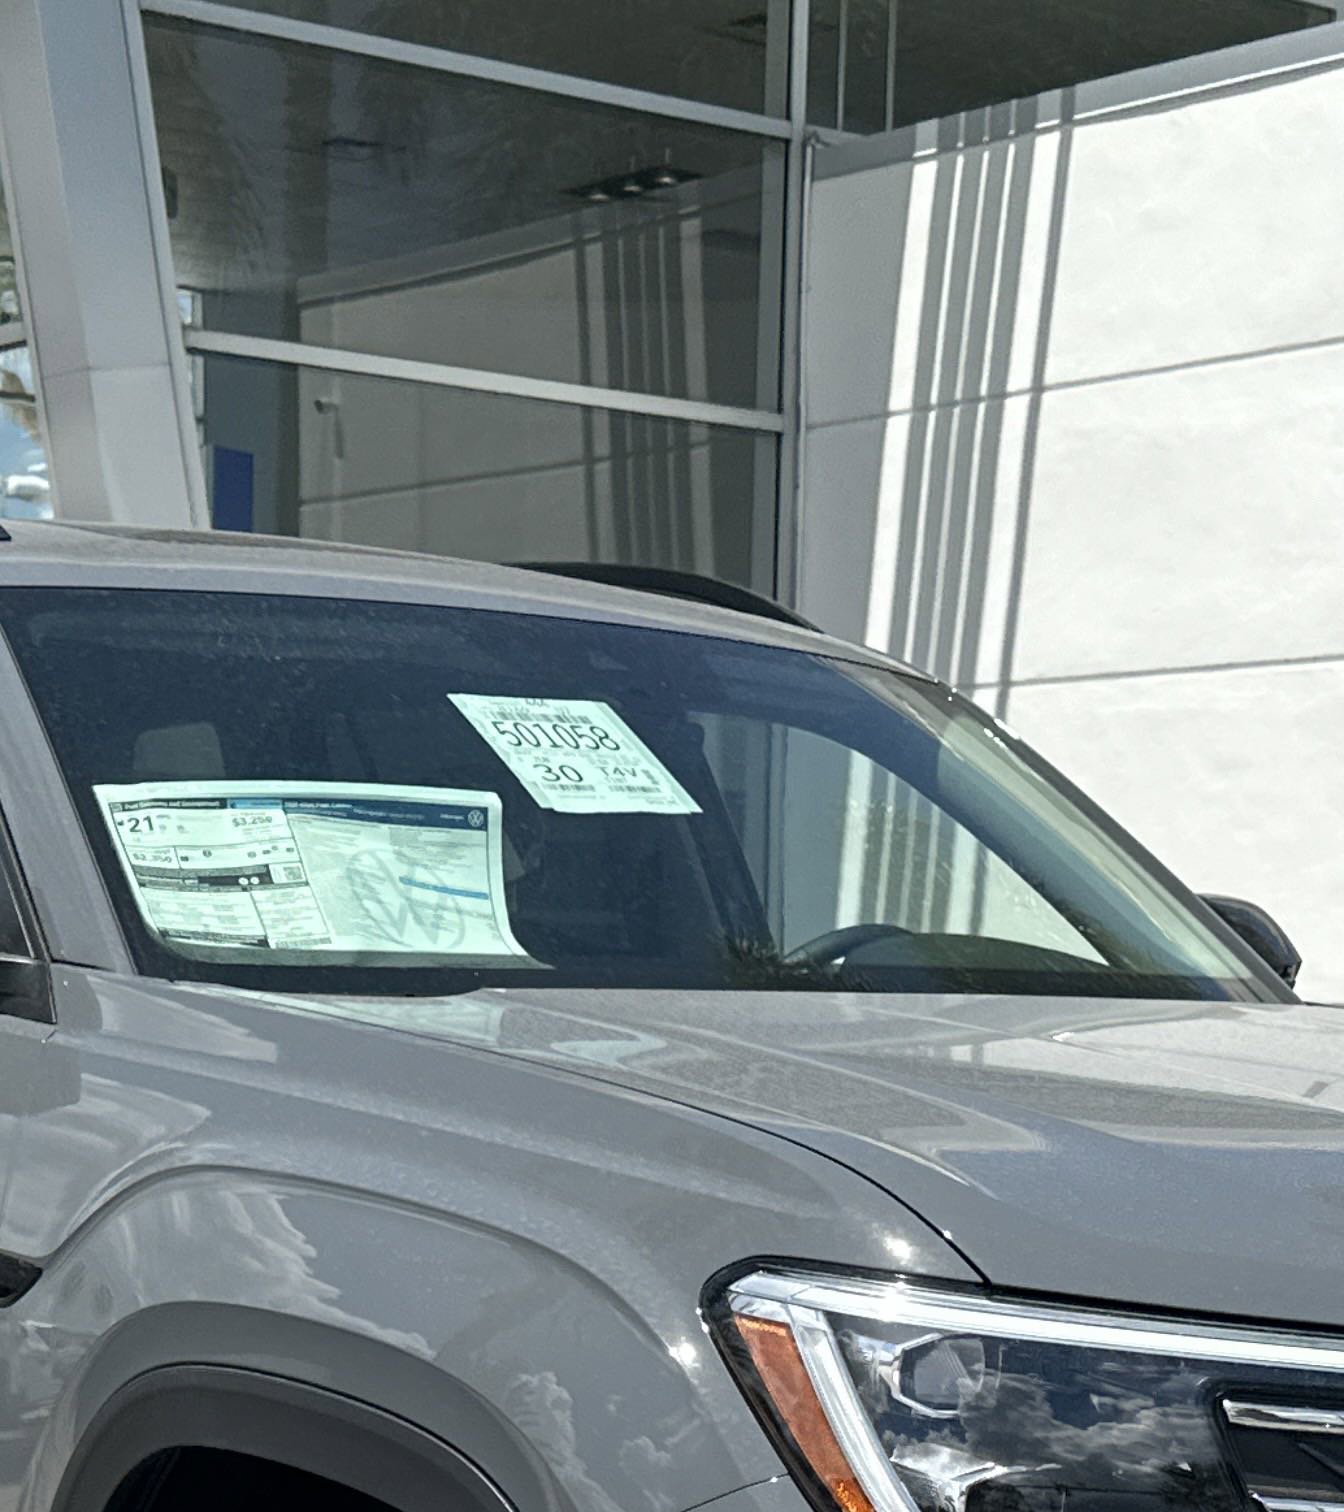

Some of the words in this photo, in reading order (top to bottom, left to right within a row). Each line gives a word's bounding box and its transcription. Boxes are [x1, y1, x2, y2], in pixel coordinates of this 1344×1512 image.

[490, 719, 622, 752] 501058
[532, 763, 584, 783] 30
[127, 815, 155, 833] 21
